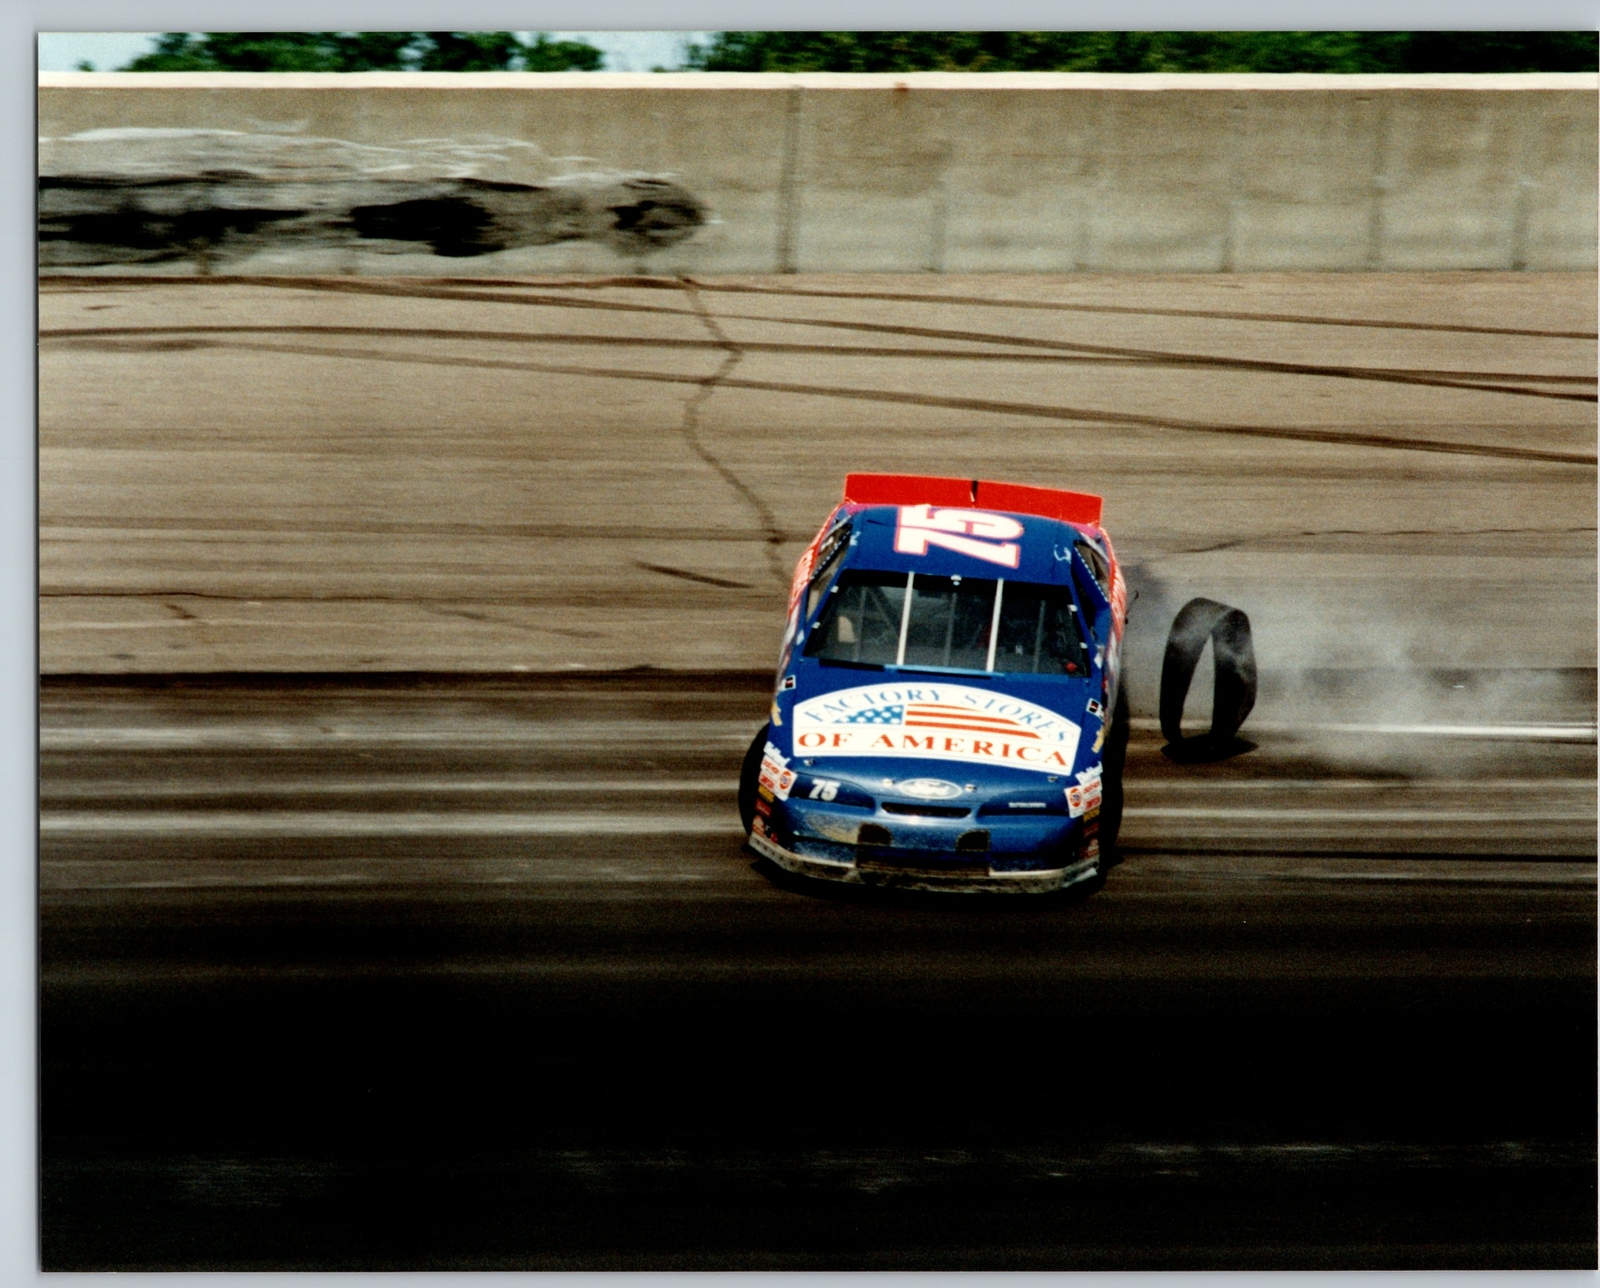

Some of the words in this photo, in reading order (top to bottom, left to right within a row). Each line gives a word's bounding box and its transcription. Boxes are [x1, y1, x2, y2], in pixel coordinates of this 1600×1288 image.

[894, 504, 1024, 569] 75
[804, 689, 942, 722] FACTORY
[962, 694, 1075, 741] STORES
[798, 732, 853, 748] OF
[870, 734, 1069, 767] AMERICA
[808, 778, 841, 801] 75
